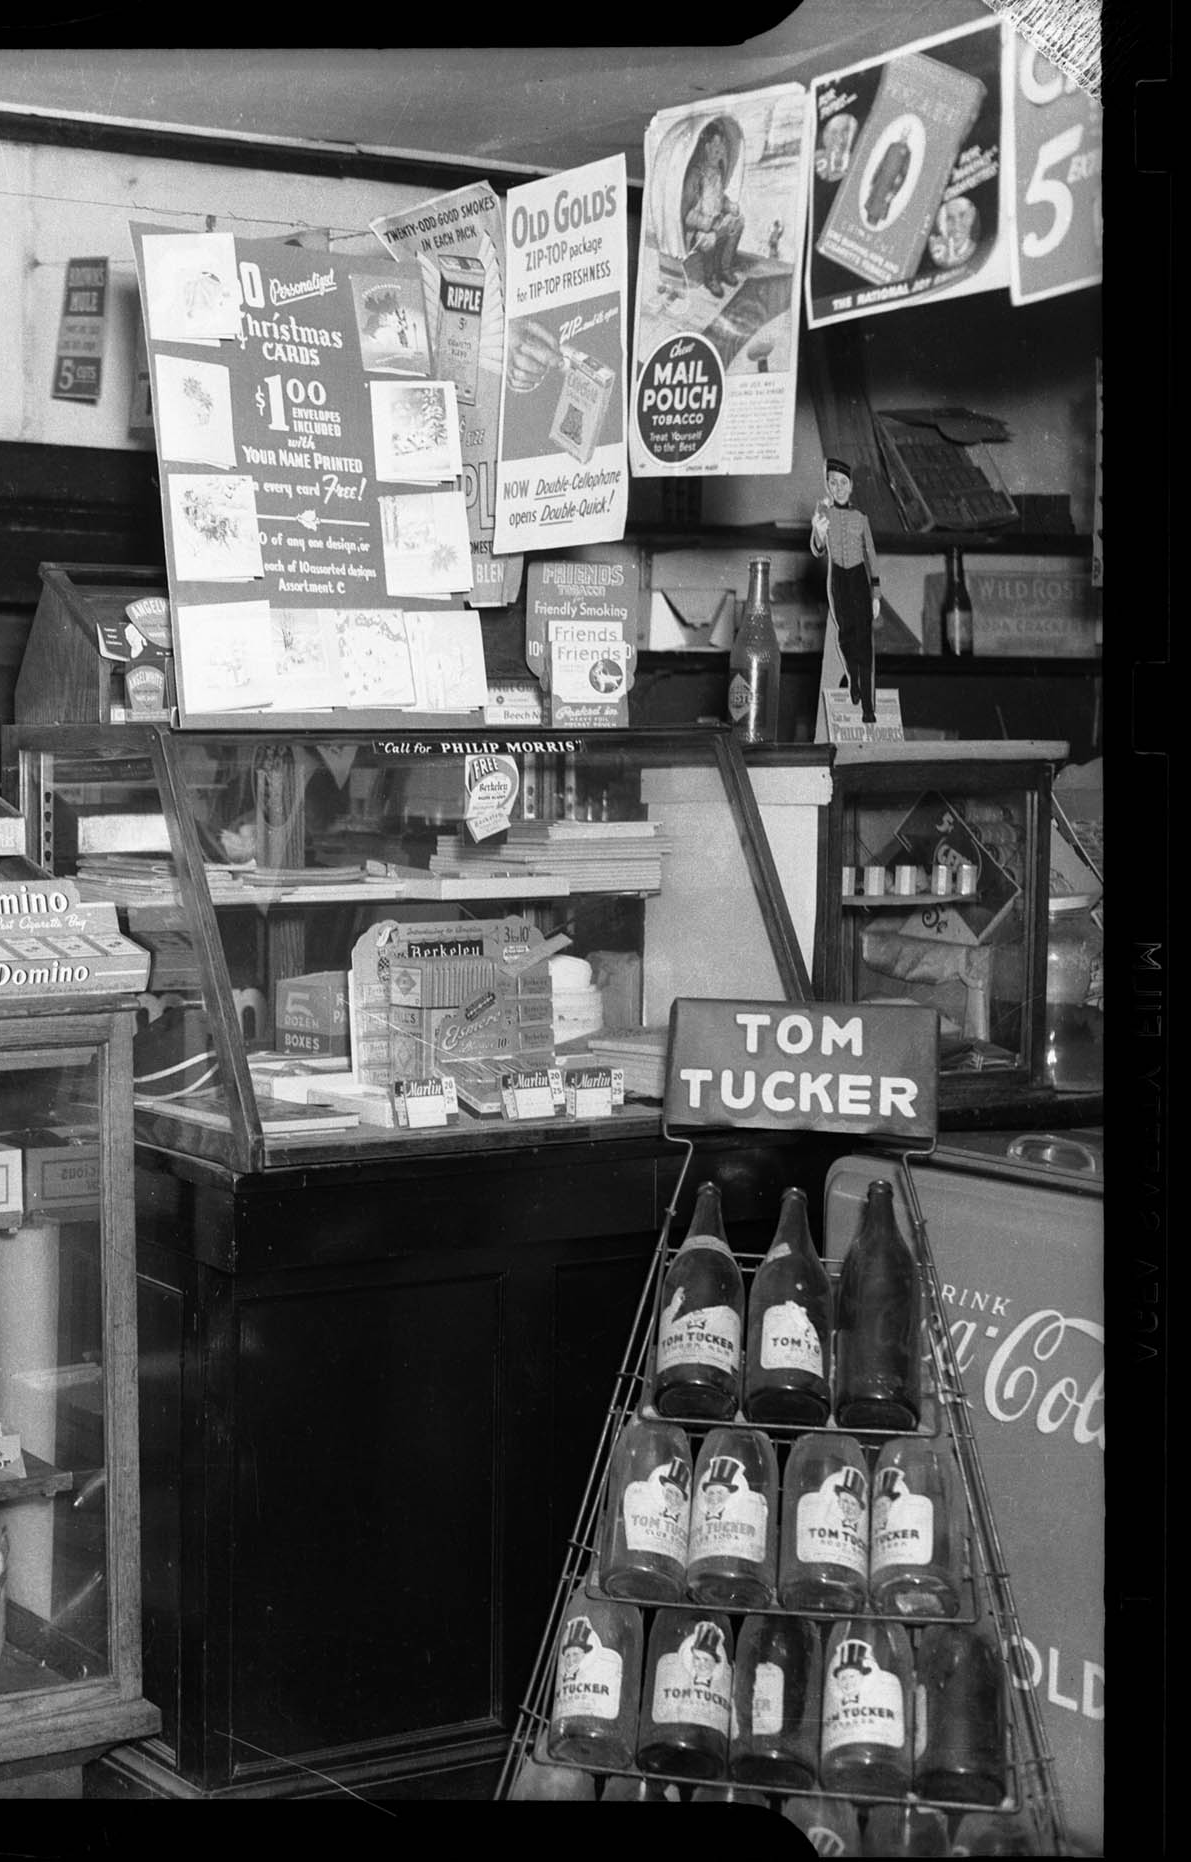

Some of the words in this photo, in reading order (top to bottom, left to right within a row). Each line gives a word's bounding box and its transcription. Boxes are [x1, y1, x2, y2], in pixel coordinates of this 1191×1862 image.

[385, 216, 437, 245] TWENTY-ODD
[437, 207, 460, 225] GOOD
[460, 195, 496, 219] SMOKES
[512, 205, 550, 249] OLD
[554, 184, 617, 234] GOLD'S
[421, 237, 432, 251] IN
[433, 231, 455, 249] EACH
[455, 224, 478, 242] PACK
[525, 239, 568, 272] ZIP-TOP
[569, 235, 603, 263] package
[269, 267, 337, 306] Personalized
[516, 287, 527, 302] for
[528, 275, 561, 300] TIP-TOP
[562, 260, 611, 290] FRESHNESS
[446, 284, 482, 312] RIPPLE
[832, 296, 852, 311] THE
[856, 283, 909, 306] NATIONAL
[236, 311, 343, 350] Christmas
[262, 341, 321, 367] CARDS
[653, 360, 709, 386] MAIL
[642, 385, 718, 412] POUCH
[292, 406, 341, 423] ENVELOPES
[652, 413, 704, 426] TOBACCO
[293, 420, 342, 437] INCLUDED
[649, 432, 669, 442] Treat
[671, 430, 703, 442] Yourself
[287, 434, 316, 450] with
[654, 444, 663, 453] to
[663, 443, 676, 452] the
[678, 441, 697, 452] Best
[241, 444, 277, 466] YOUR
[278, 448, 312, 469] NAME
[312, 452, 364, 473] PRINTED
[263, 482, 293, 499] every
[296, 482, 321, 497] card
[503, 479, 530, 500] NOW
[534, 468, 622, 500] Double-Cellophane
[509, 510, 537, 528] opens
[539, 489, 616, 526] Double-Quick!
[271, 532, 283, 546] of
[286, 538, 306, 552] any
[308, 539, 325, 549] one
[264, 559, 285, 573] each
[287, 560, 298, 573] of
[347, 564, 377, 581] designs
[542, 562, 625, 586] FRIENDS
[278, 578, 335, 593] Assortment
[336, 581, 346, 593] C
[557, 583, 607, 597] TOBACCO
[534, 600, 578, 619] Friendly
[579, 601, 628, 620] Smoking
[554, 625, 618, 642] Friends
[557, 645, 622, 661] Friends
[503, 710, 531, 720] Beech
[832, 723, 865, 742] PHILIP
[865, 724, 903, 742] MORRIS
[378, 741, 411, 754] "Call
[412, 742, 432, 754] for
[440, 742, 501, 754] PHILIP
[508, 740, 582, 753] MORRIS"
[471, 756, 500, 780] FREE
[478, 782, 508, 796] Berkeley
[18, 915, 63, 932] Cigarette
[284, 1014, 320, 1030] DOZEN
[284, 1033, 321, 1050] BOXES
[735, 1012, 864, 1057] TOM
[514, 1072, 549, 1089] Marlin
[550, 1072, 560, 1081] 20
[577, 1072, 611, 1089] Marlin
[613, 1072, 623, 1081] 20
[407, 1079, 443, 1098] Marlin
[679, 1067, 919, 1118] TUCKER
[661, 1333, 684, 1349] TOM
[688, 1331, 735, 1353] TUCKER
[772, 1337, 802, 1348] TOM
[631, 1514, 661, 1529] TOM
[705, 1520, 756, 1538] TUCKER
[808, 1527, 839, 1540] TOM
[562, 1682, 610, 1697] TUCKER
[663, 1687, 691, 1699] TOM
[842, 1706, 895, 1721] TUCKER
